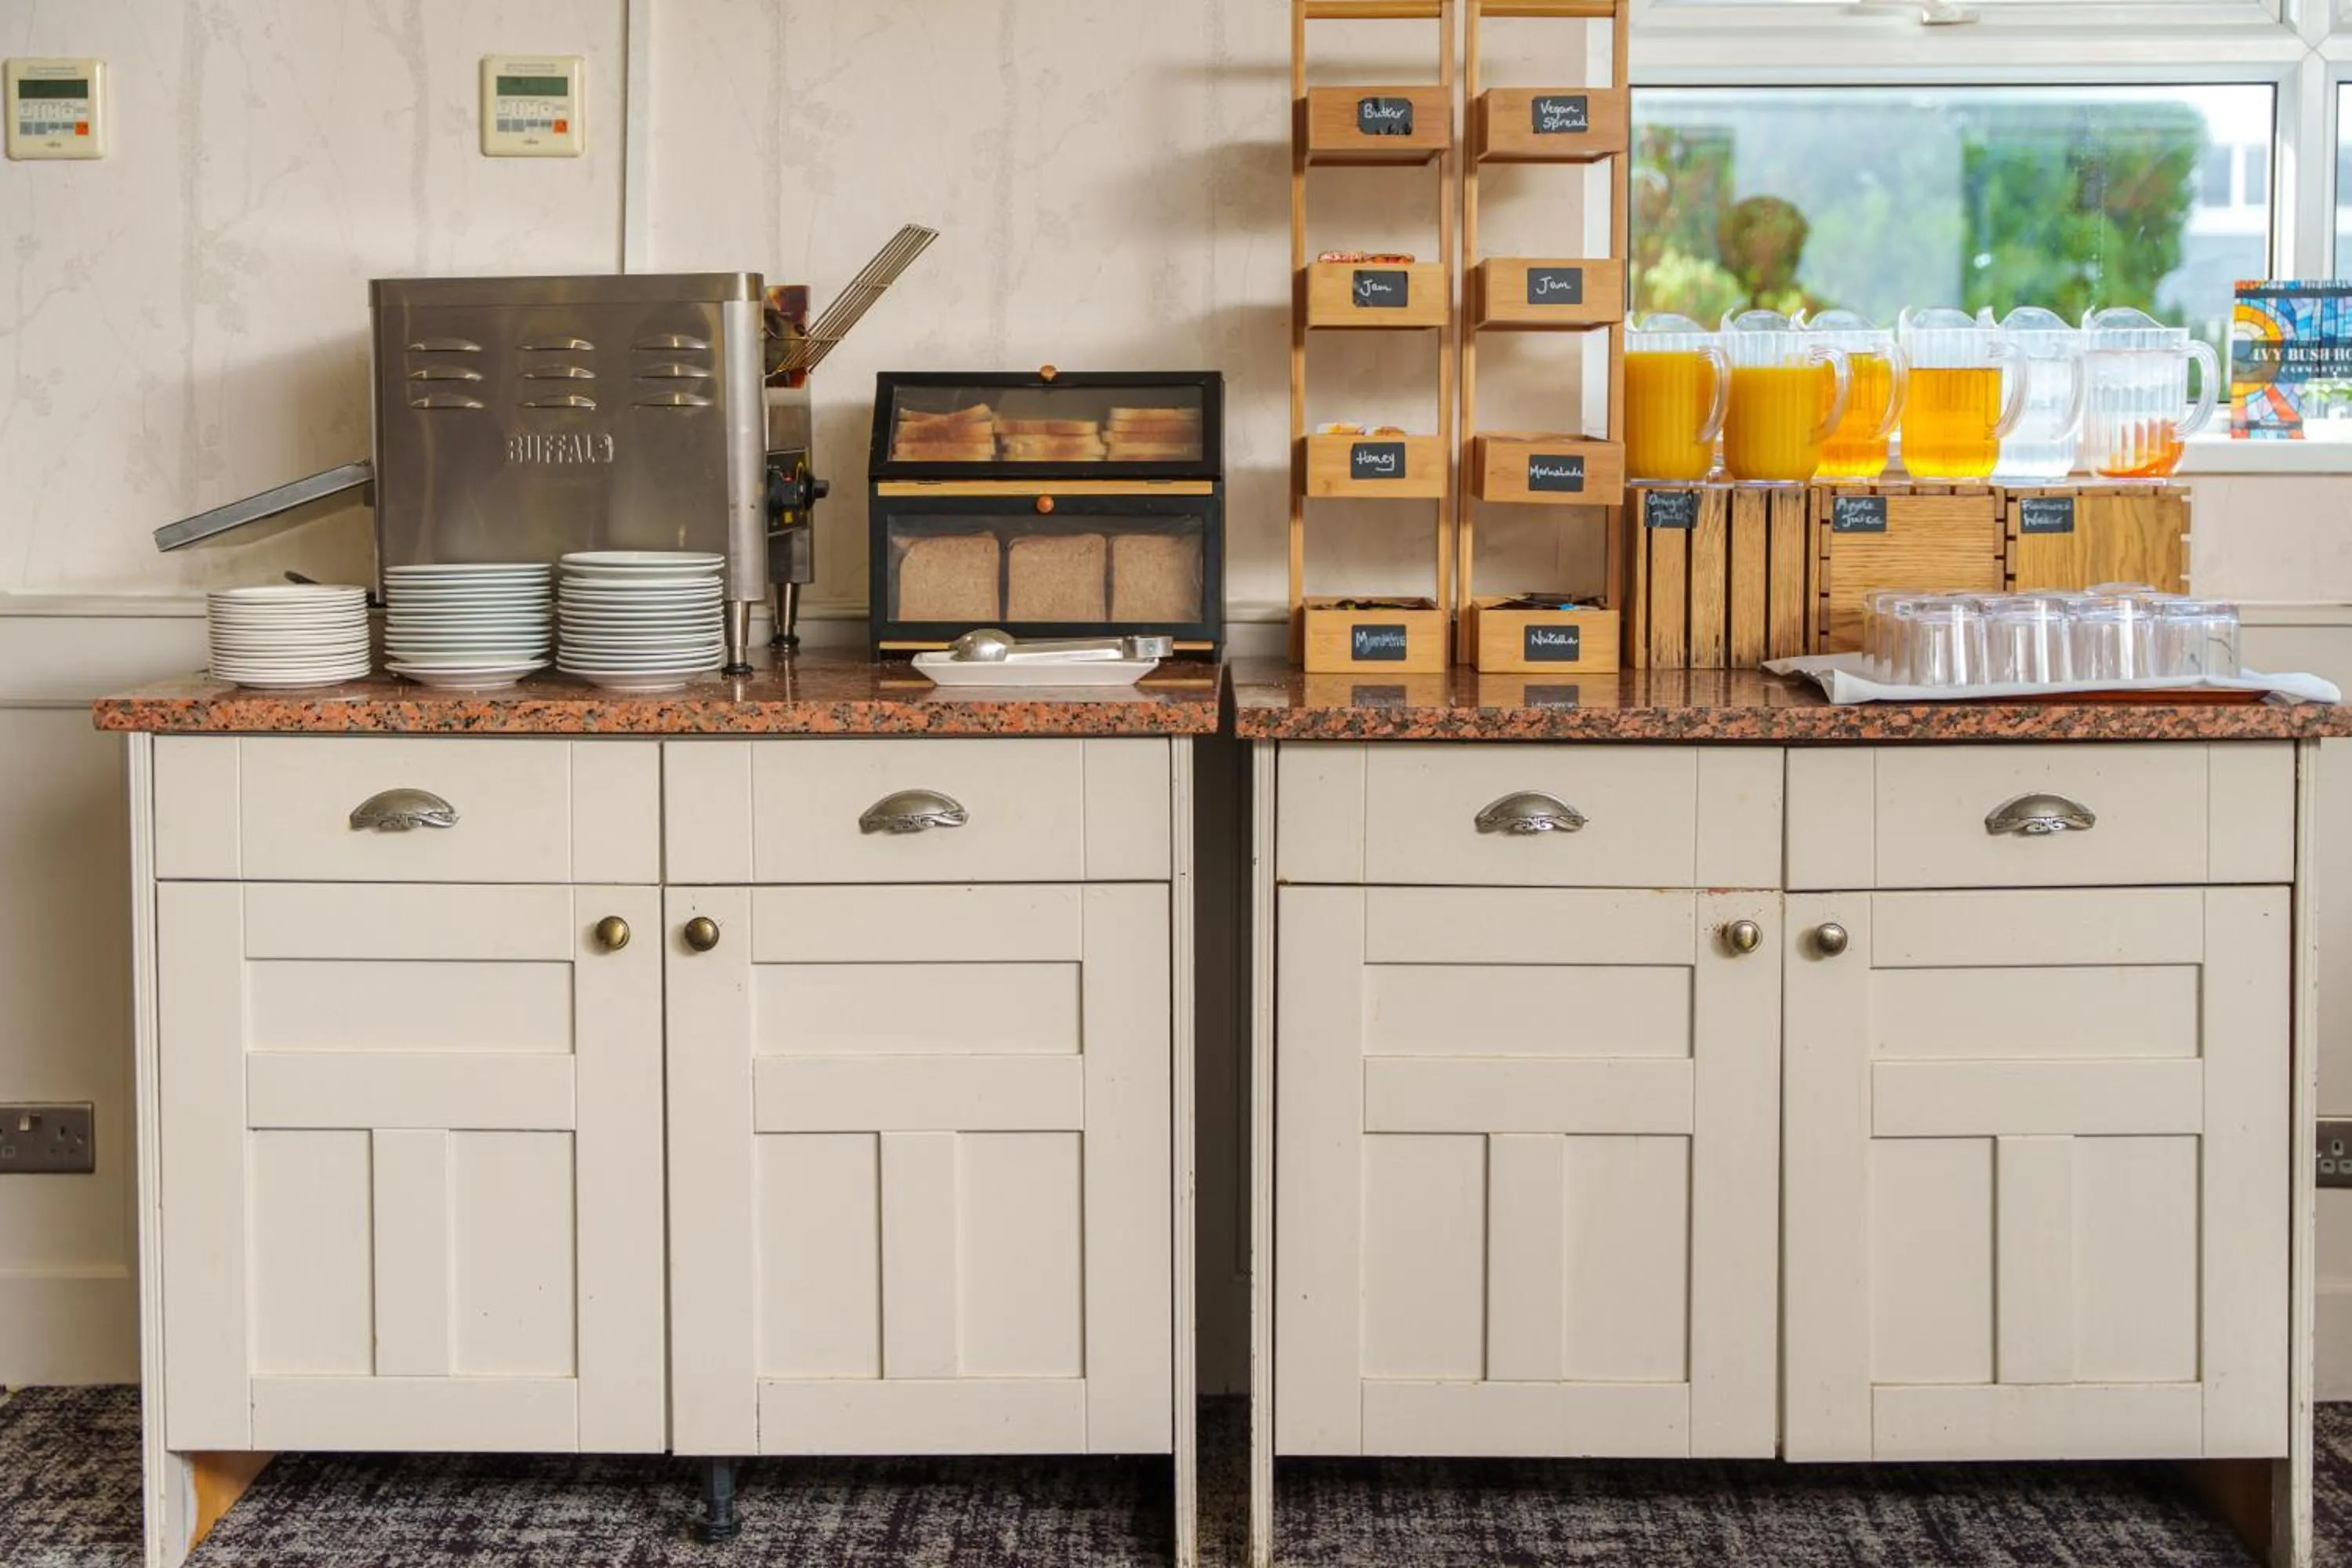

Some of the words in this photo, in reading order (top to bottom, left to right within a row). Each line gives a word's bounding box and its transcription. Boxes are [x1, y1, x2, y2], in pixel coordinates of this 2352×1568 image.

[1363, 103, 1405, 119] Butter
[1540, 100, 1580, 119] Vegan
[1359, 278, 1392, 297] Jam
[1536, 275, 1572, 296] Jam
[2252, 347, 2281, 361] IVY
[2288, 347, 2330, 361] BUSH
[508, 432, 615, 464] BUFFALO
[1356, 450, 1395, 471] Honey
